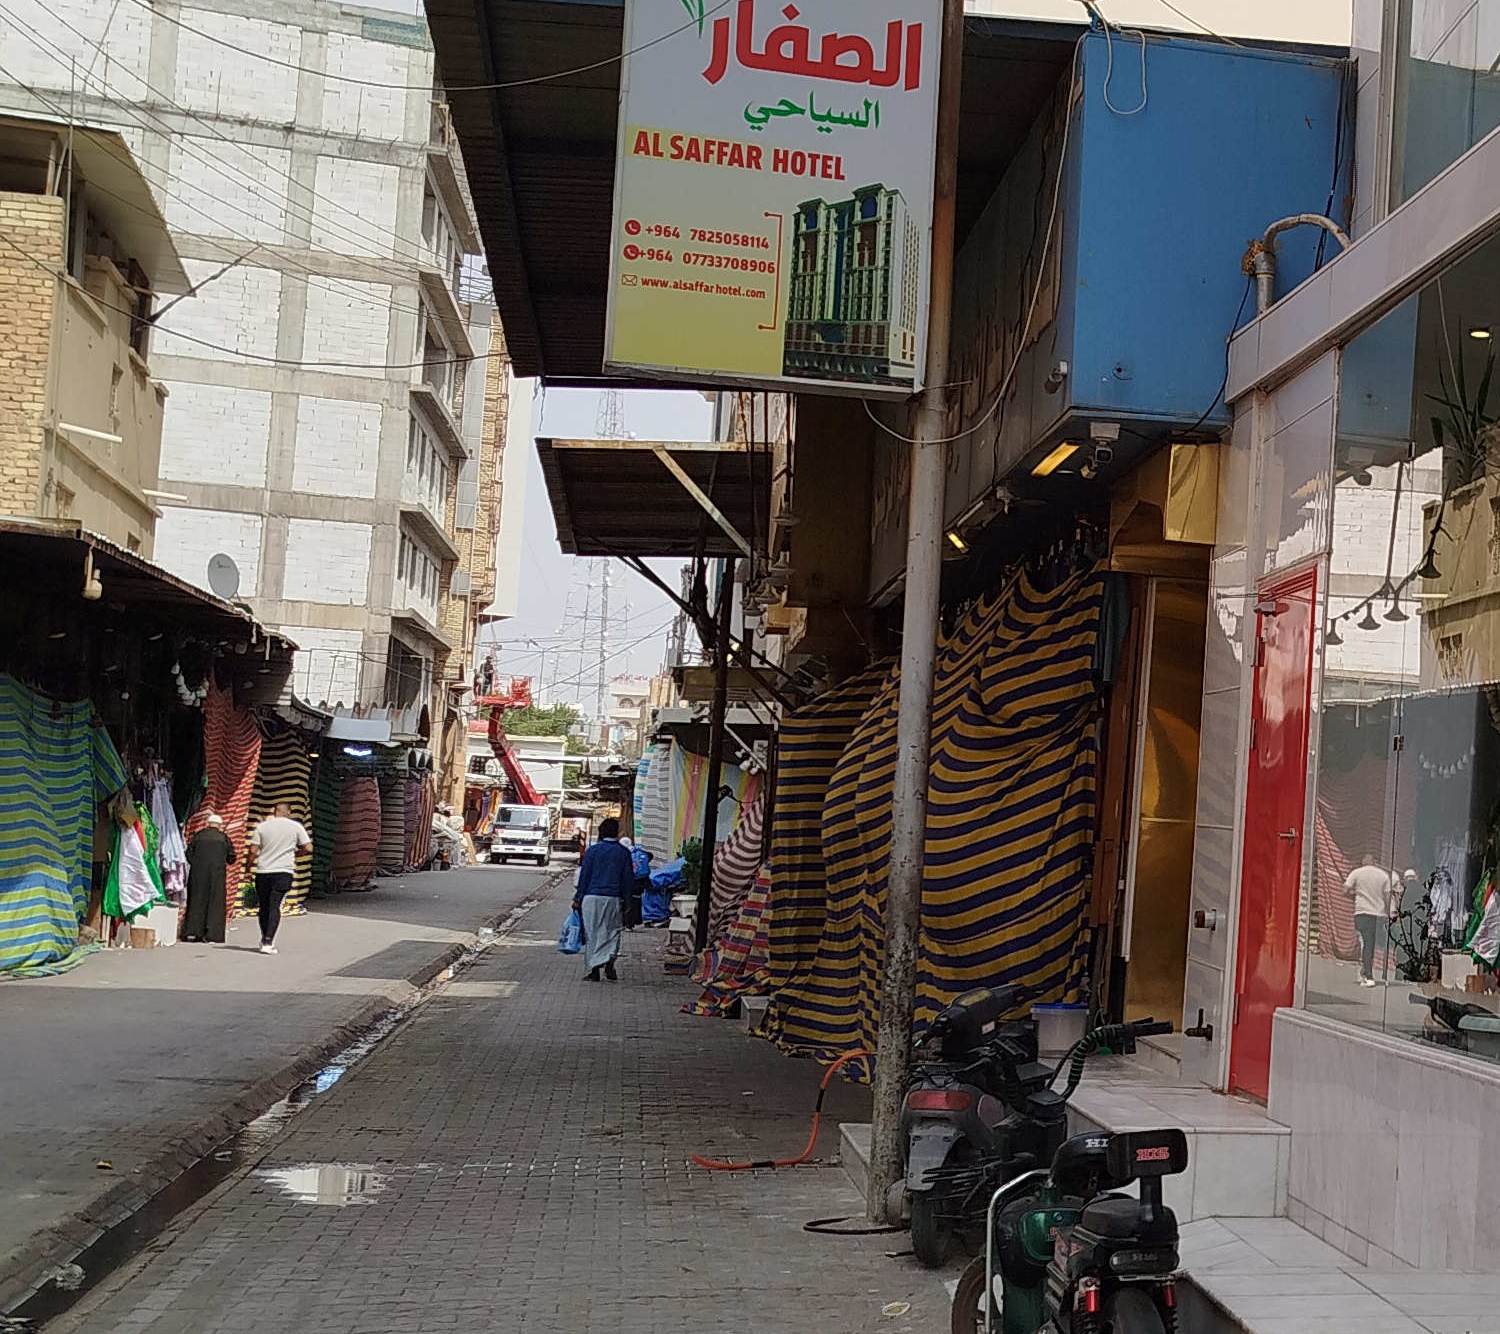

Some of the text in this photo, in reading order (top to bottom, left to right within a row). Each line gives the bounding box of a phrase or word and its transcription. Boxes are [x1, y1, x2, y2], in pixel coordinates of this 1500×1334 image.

[743, 91, 880, 132] السياحي
[633, 130, 846, 181] AL SAFFAR HOTEL
[644, 224, 770, 250] +964 7825058114
[638, 248, 775, 274] +964 07733708906
[1085, 1138, 1109, 1148] HI
